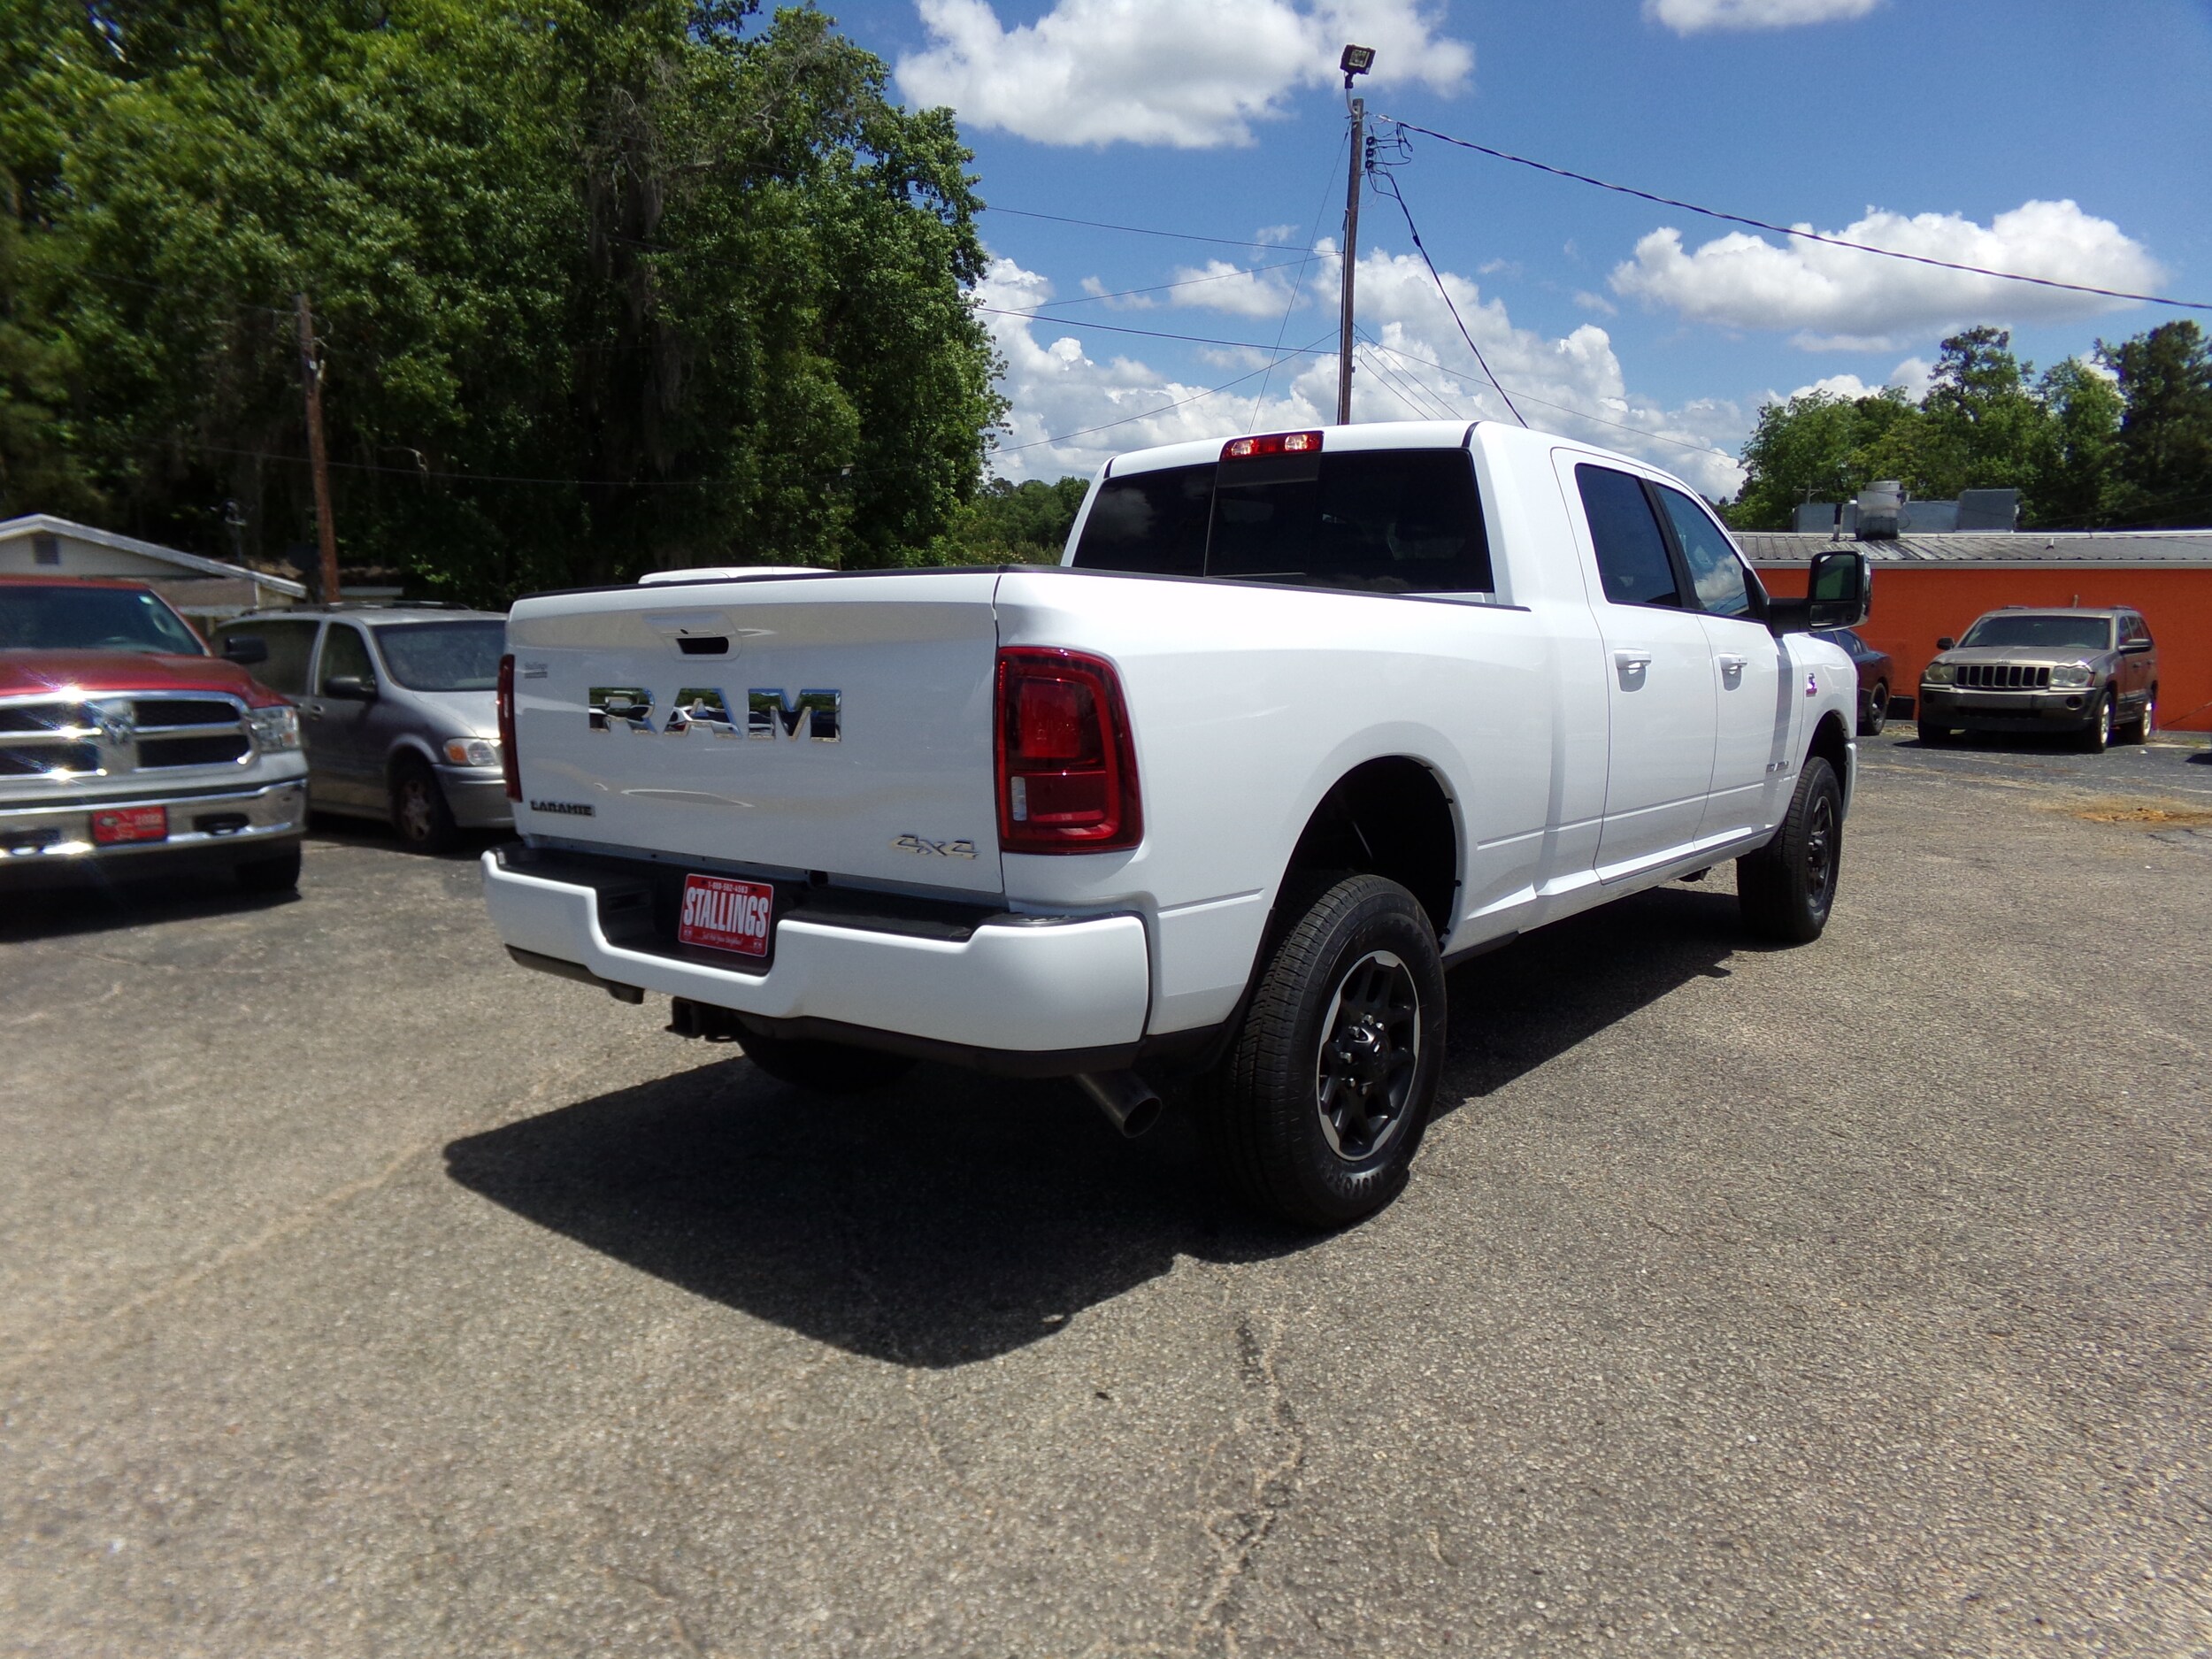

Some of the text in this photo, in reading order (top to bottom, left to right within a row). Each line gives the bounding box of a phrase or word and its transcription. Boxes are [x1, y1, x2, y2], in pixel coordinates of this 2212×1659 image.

[588, 687, 841, 742] RAM
[530, 800, 595, 817] LARAMIE
[890, 834, 979, 859] 4x4
[683, 887, 769, 938] STALLINGS
